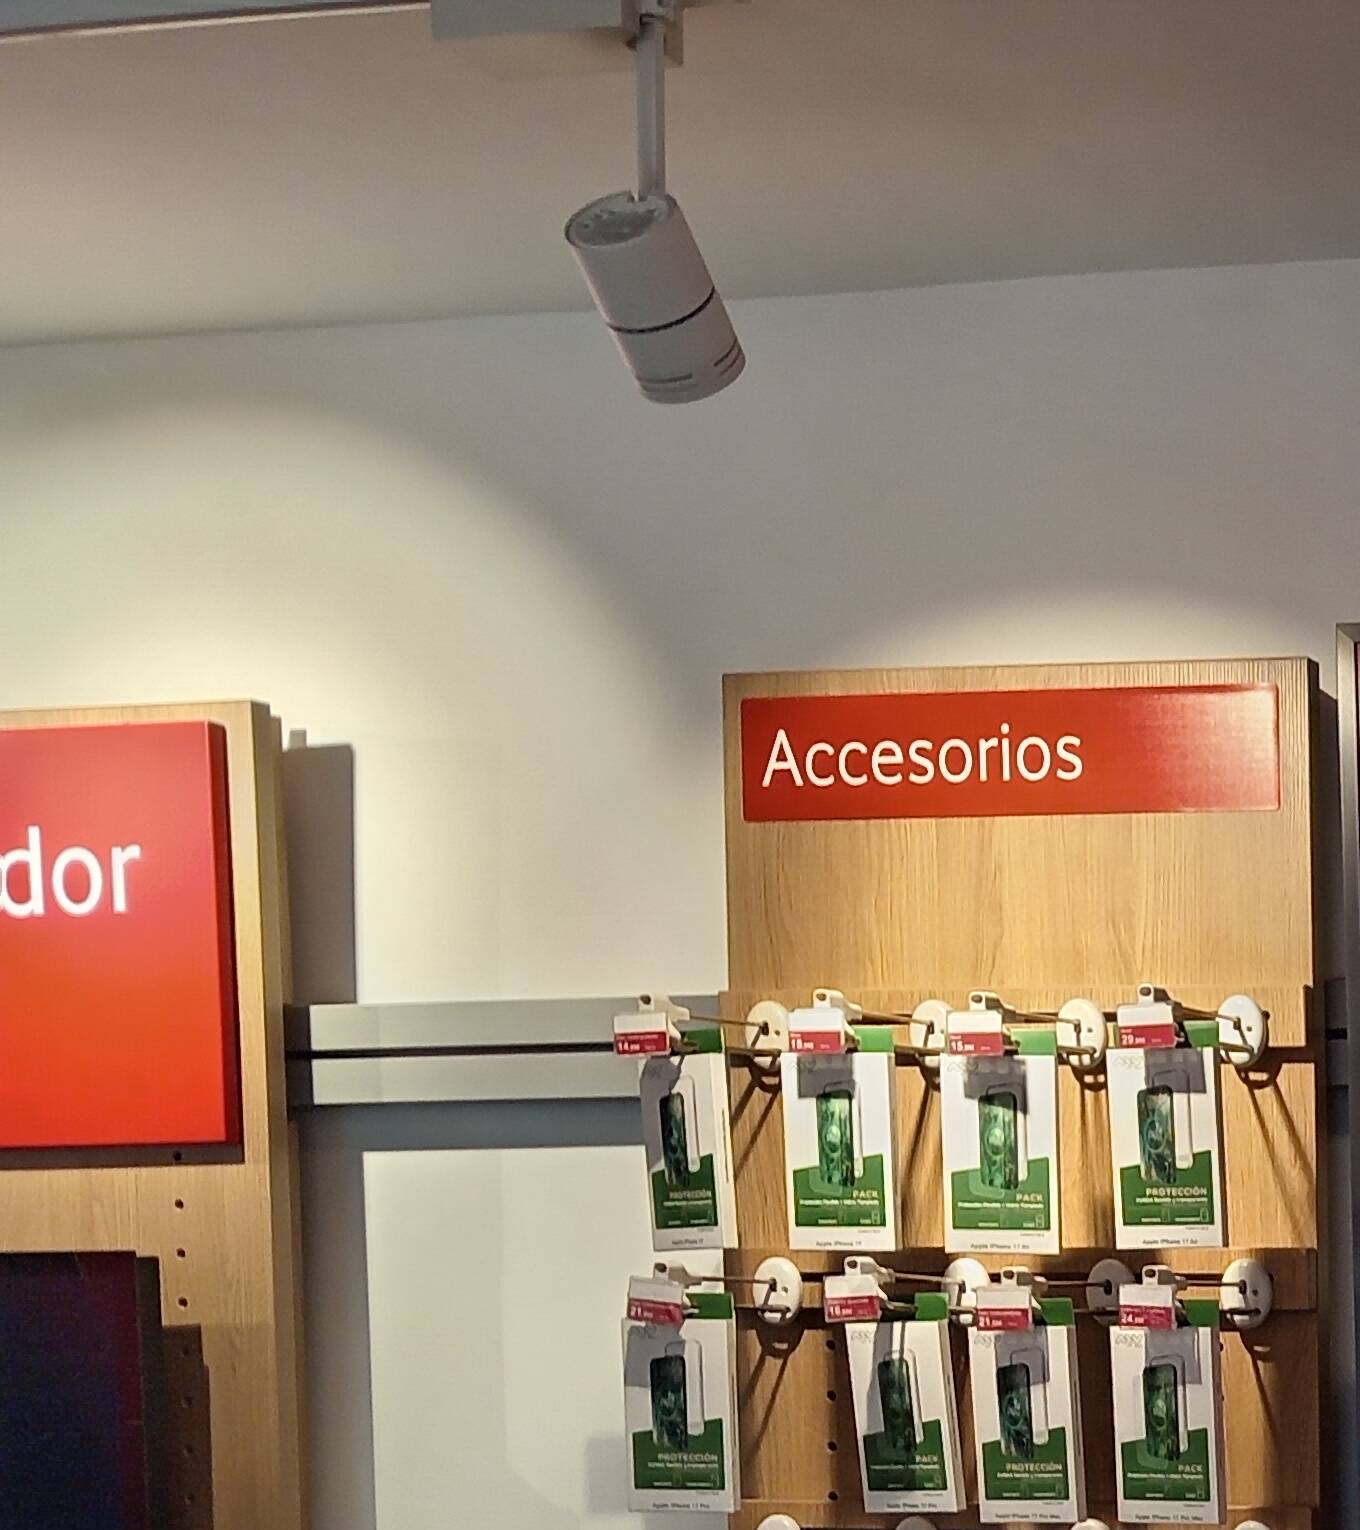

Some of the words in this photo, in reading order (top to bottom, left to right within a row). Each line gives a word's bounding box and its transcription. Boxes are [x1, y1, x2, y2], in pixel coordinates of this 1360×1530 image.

[762, 722, 1083, 788] Accesorios
[0, 825, 142, 917] dor
[1145, 1187, 1207, 1197] PROTECCIÓN
